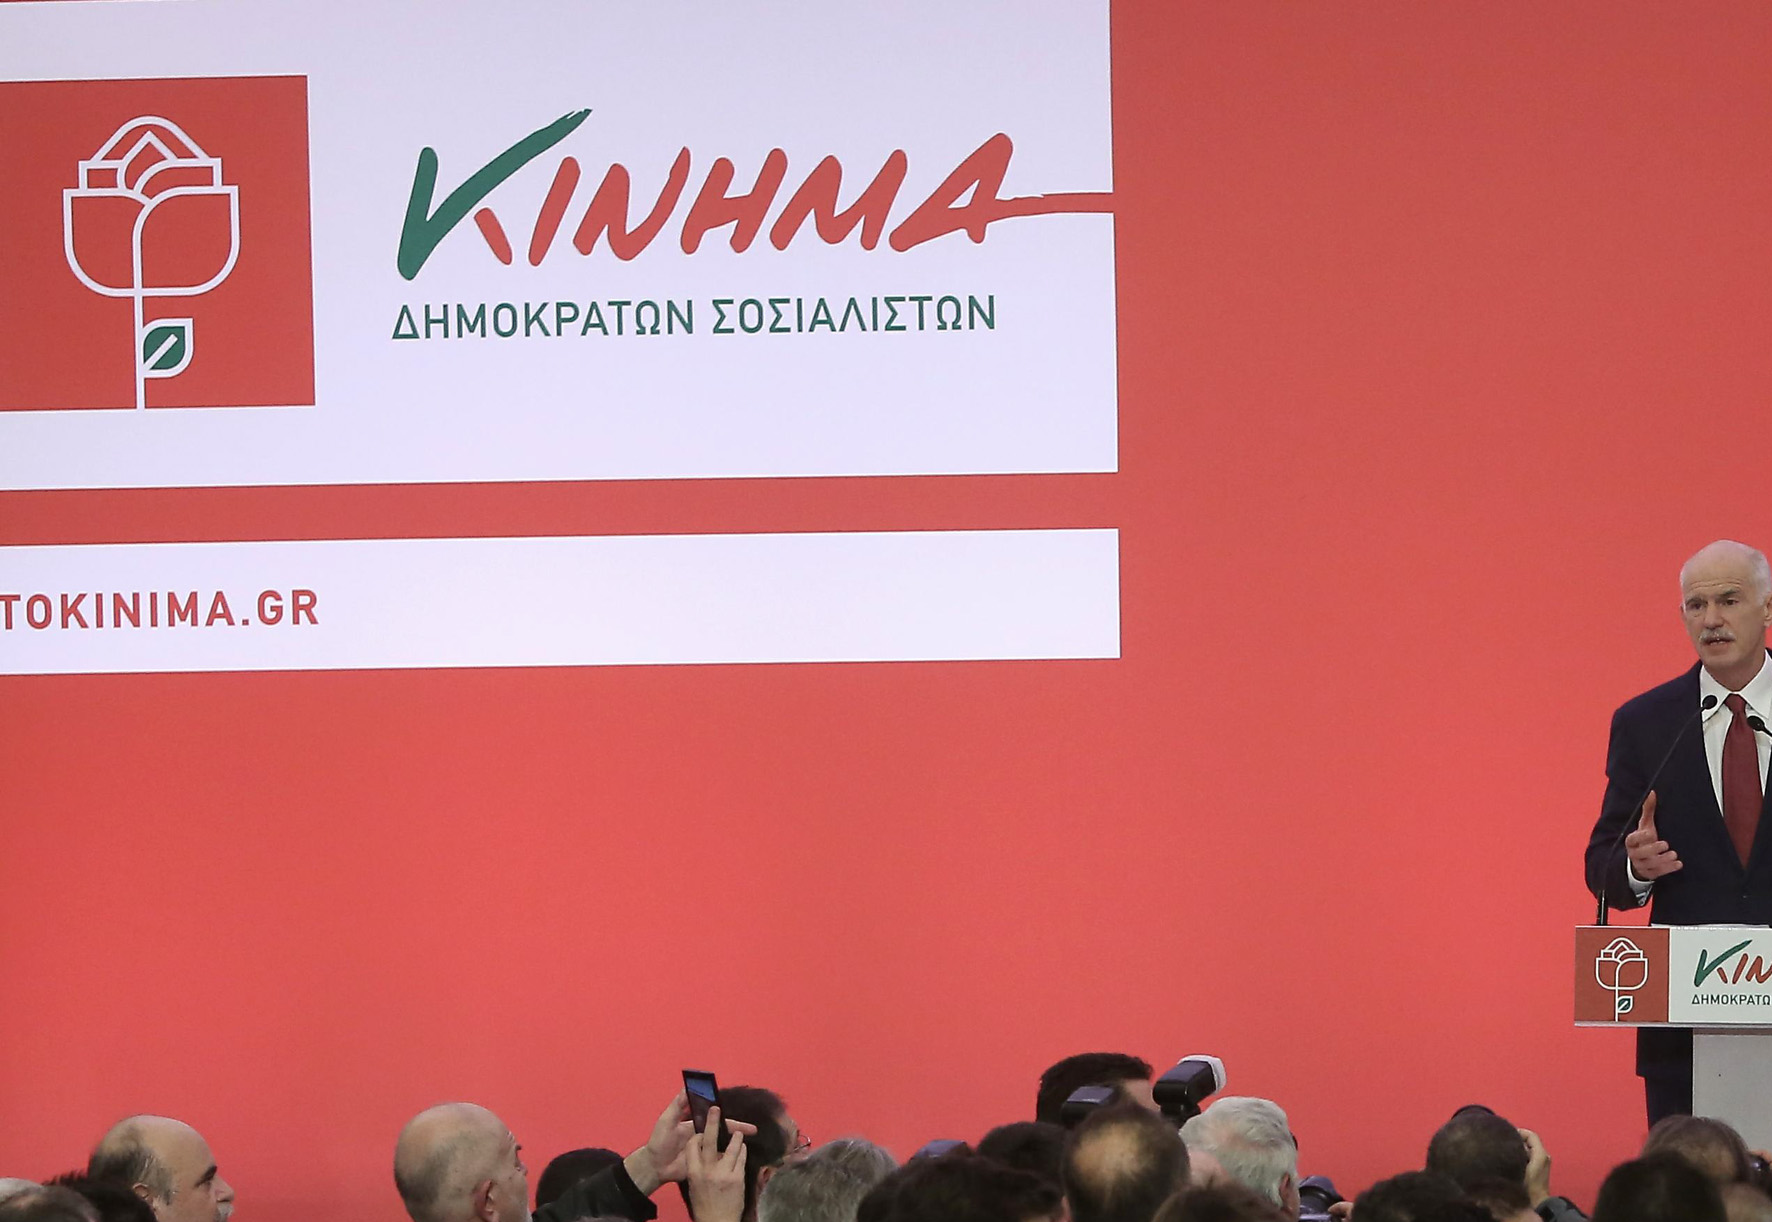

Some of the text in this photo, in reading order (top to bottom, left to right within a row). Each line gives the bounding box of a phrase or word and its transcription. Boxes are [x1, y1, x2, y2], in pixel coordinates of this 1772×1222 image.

[397, 106, 1112, 281] ΚΙΝΗΜΑ
[392, 295, 994, 339] ΔΗΜΟΚΡΑΤΩΝ ΣΟΣΙΑΛΙΣΤΩΝ
[0, 590, 318, 630] TOKINIMA.GR
